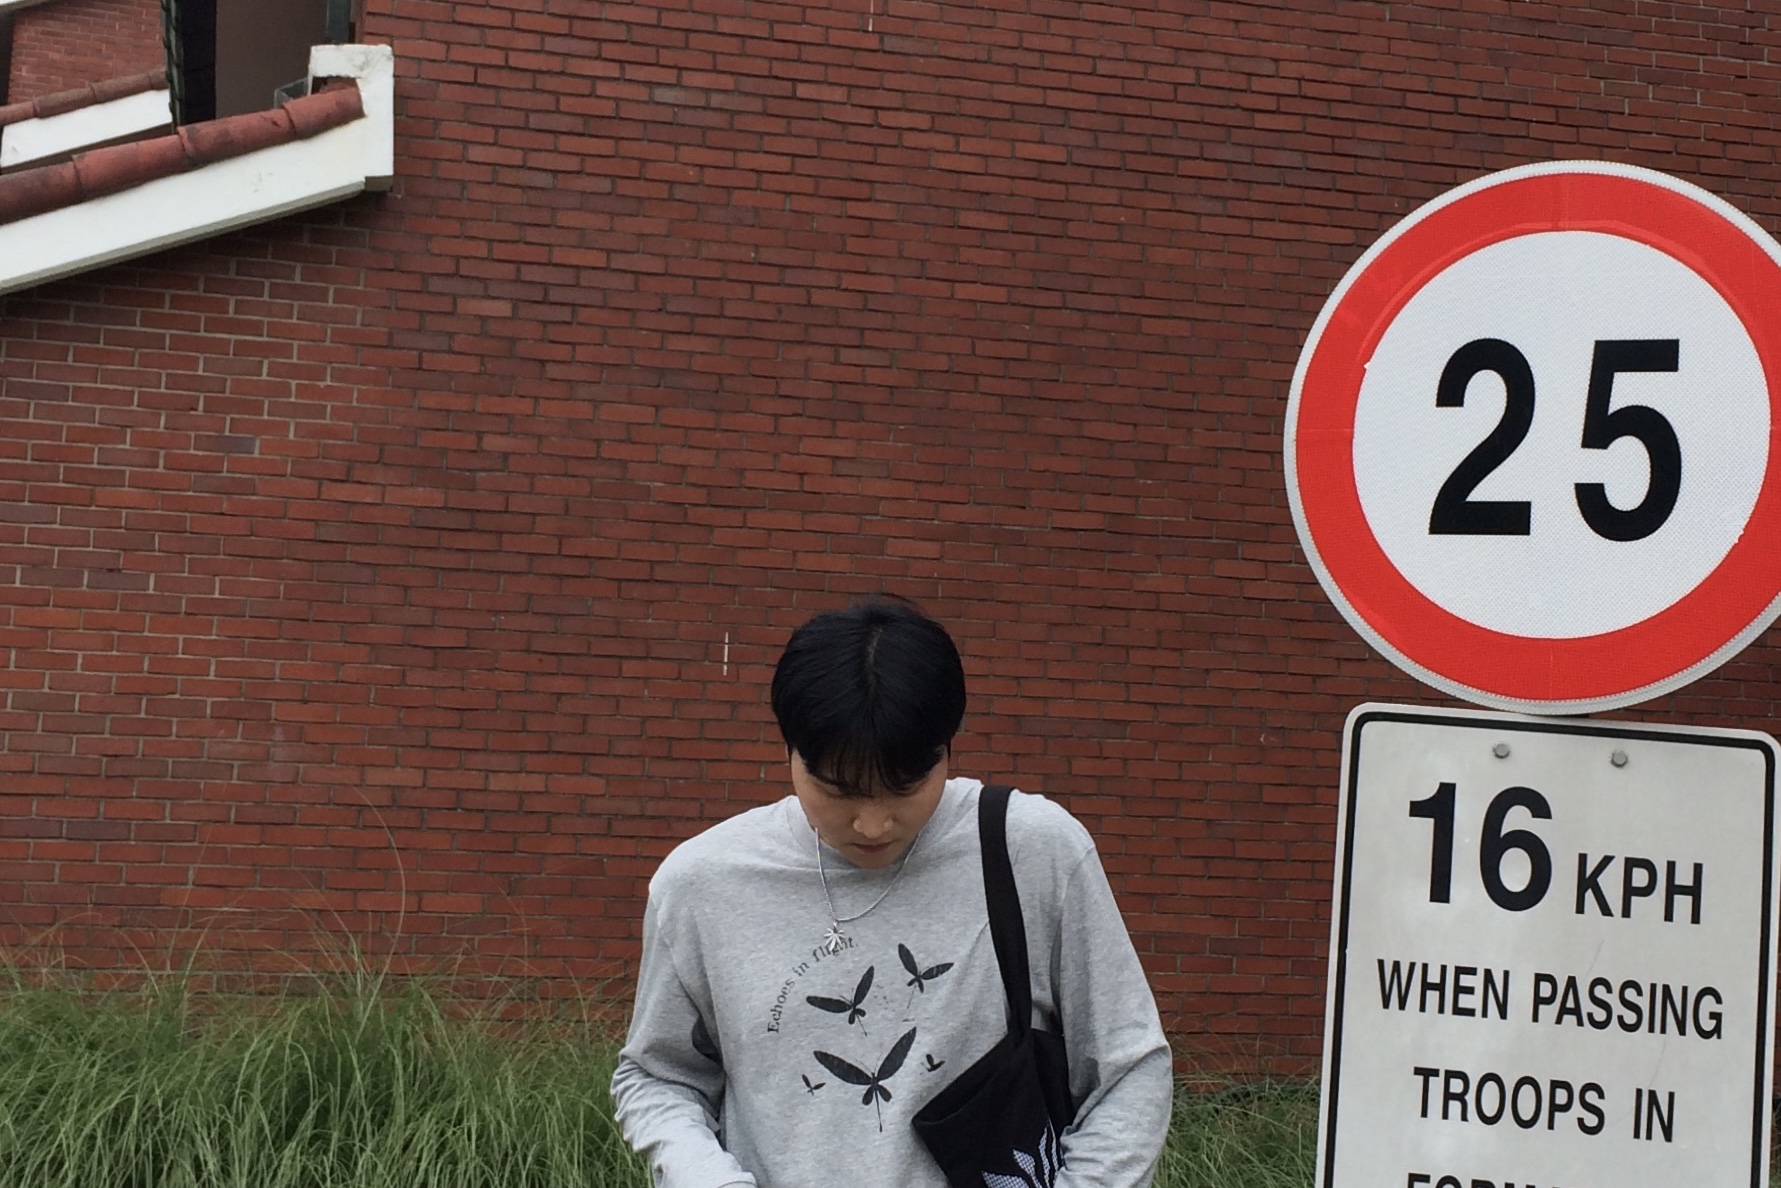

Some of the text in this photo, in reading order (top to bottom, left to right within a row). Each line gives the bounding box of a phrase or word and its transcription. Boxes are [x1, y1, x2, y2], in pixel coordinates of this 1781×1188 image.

[1428, 338, 1682, 542] 25
[1408, 782, 1704, 925] 16 KPH
[767, 978, 795, 1033] Echoes
[792, 962, 810, 977] in
[1377, 958, 1723, 1040] WHEN PASSING
[1413, 1066, 1676, 1143] TROOPS IN
